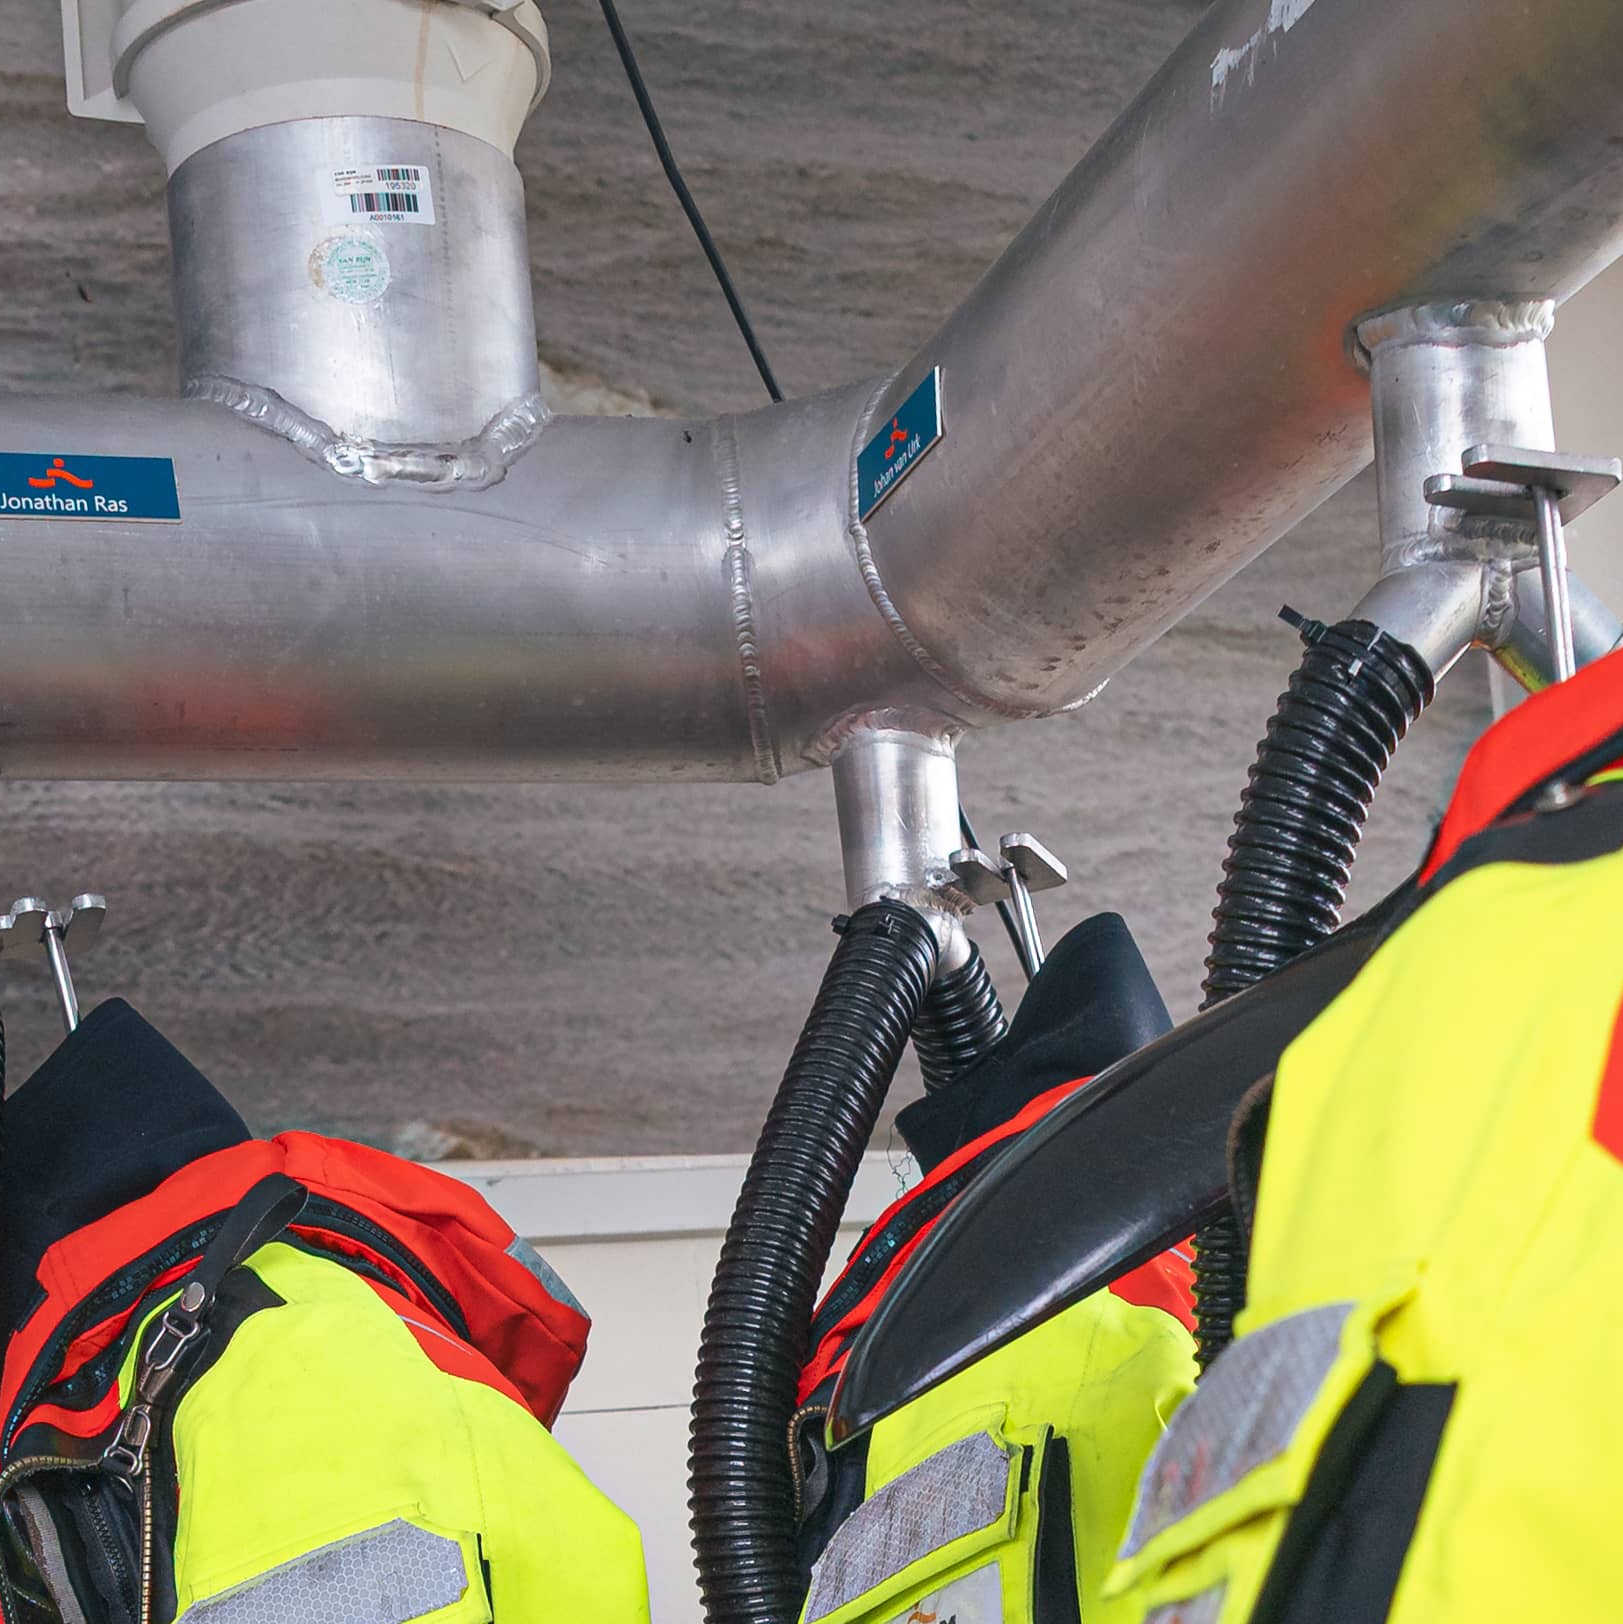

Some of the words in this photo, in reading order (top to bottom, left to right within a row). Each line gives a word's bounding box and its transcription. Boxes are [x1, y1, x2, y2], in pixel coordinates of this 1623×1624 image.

[907, 433, 921, 458] Urk
[0, 492, 89, 512] Jonathan
[95, 495, 129, 513] Ras
